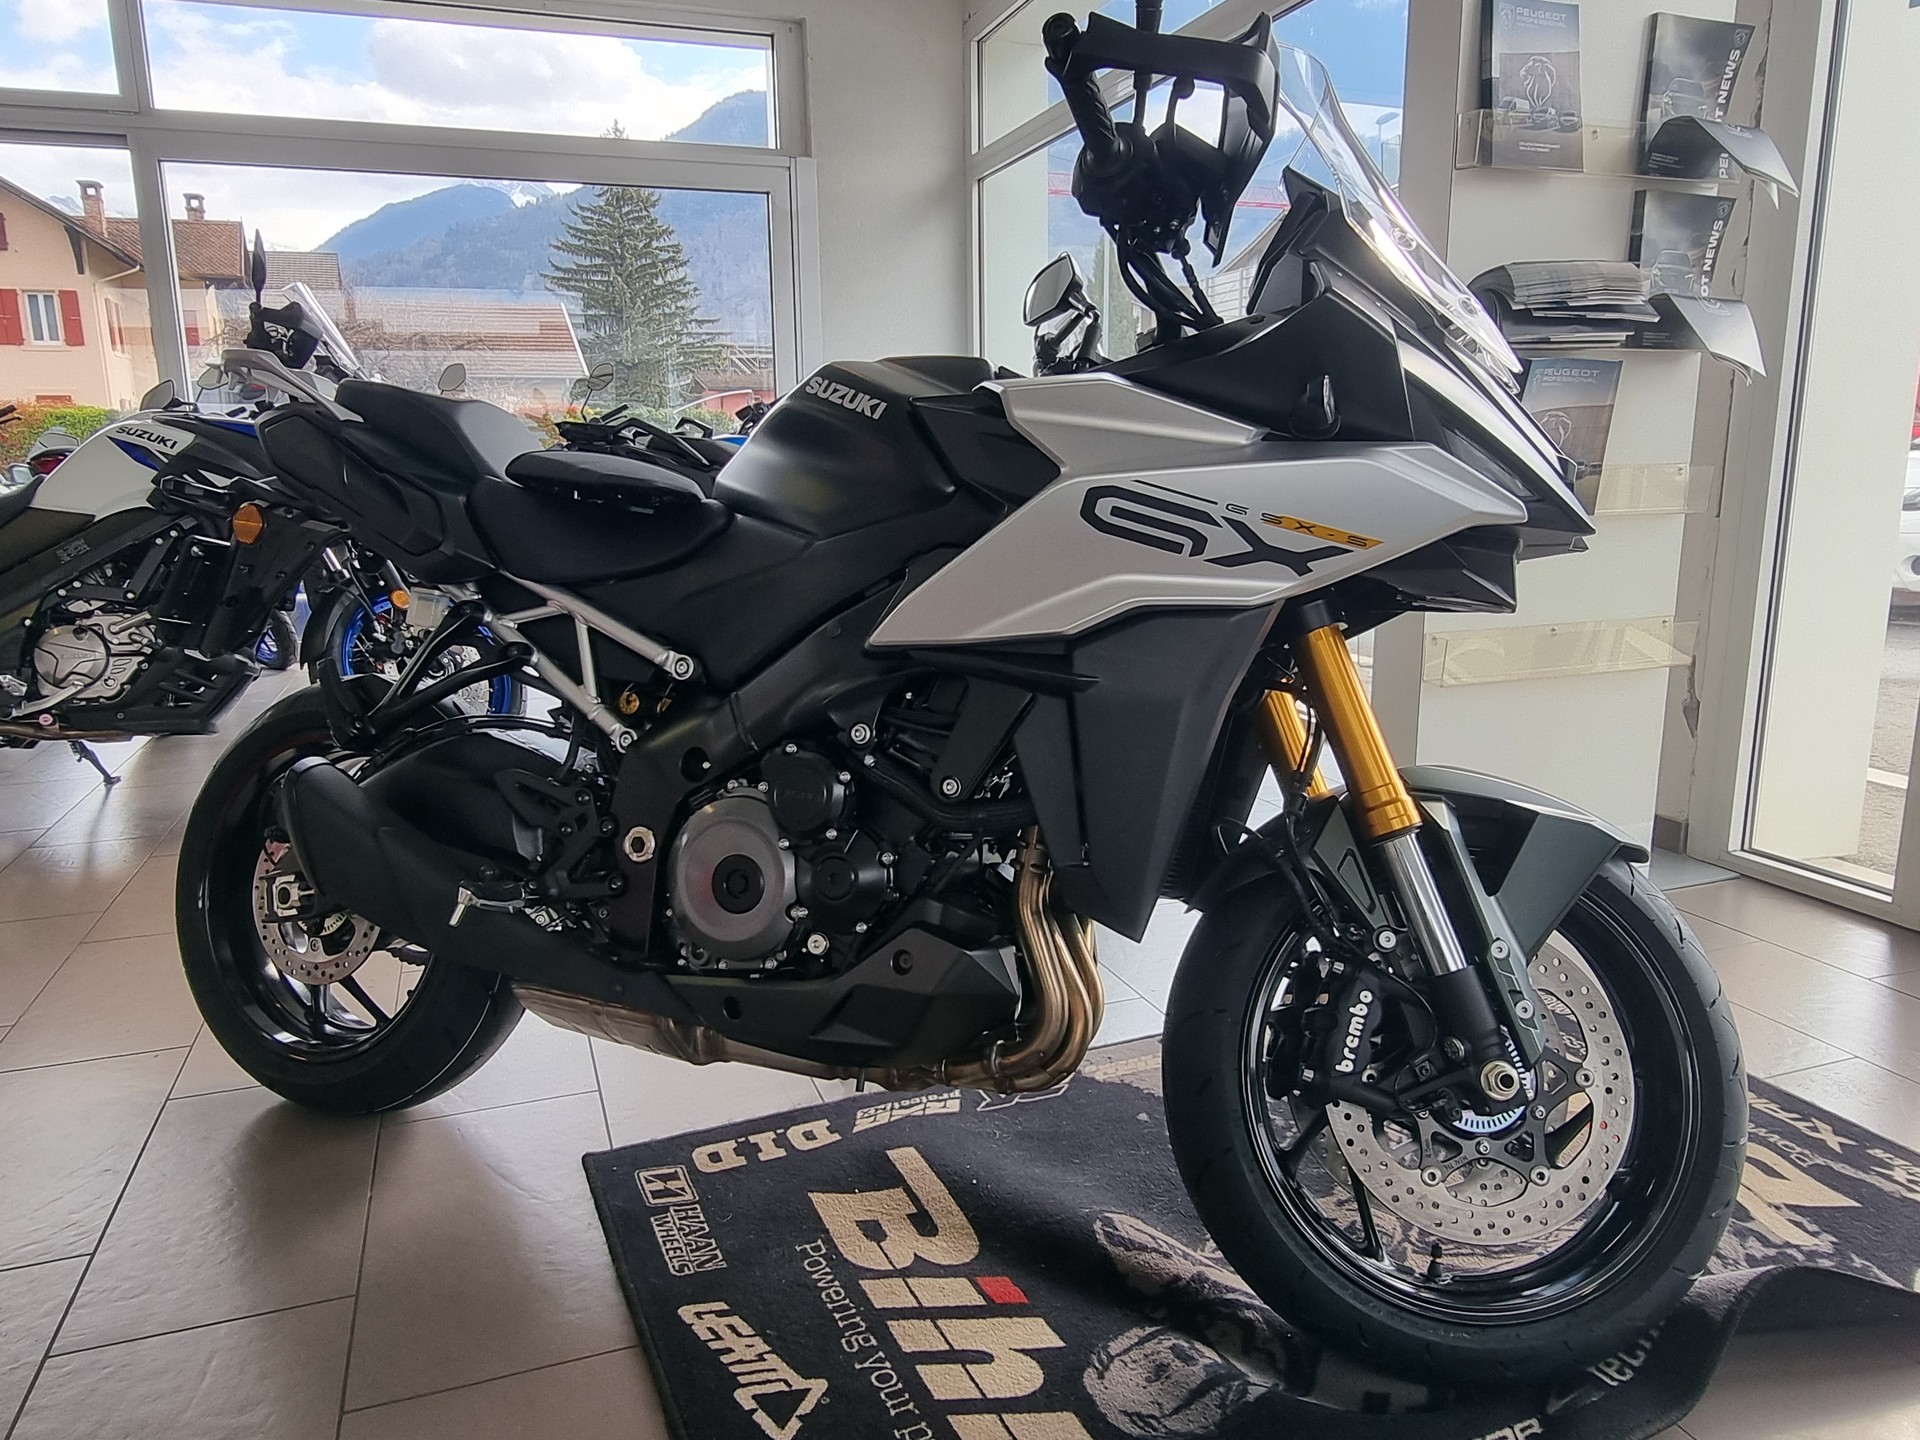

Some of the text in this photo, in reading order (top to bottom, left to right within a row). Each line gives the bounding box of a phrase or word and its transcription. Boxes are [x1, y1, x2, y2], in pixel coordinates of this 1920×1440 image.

[1516, 6, 1568, 21] PEUGEOT
[1717, 48, 1741, 104] NEWS
[1702, 220, 1724, 271] NEWS
[805, 376, 888, 420] SUZUKI
[1543, 367, 1601, 377] PEUGEOT
[115, 425, 178, 450] SUZUKI
[1335, 990, 1374, 1074] brembo
[650, 1211, 696, 1277] WHEELS
[669, 1203, 728, 1272] HAAN
[795, 1237, 879, 1353] Powering
[855, 1350, 920, 1417] your
